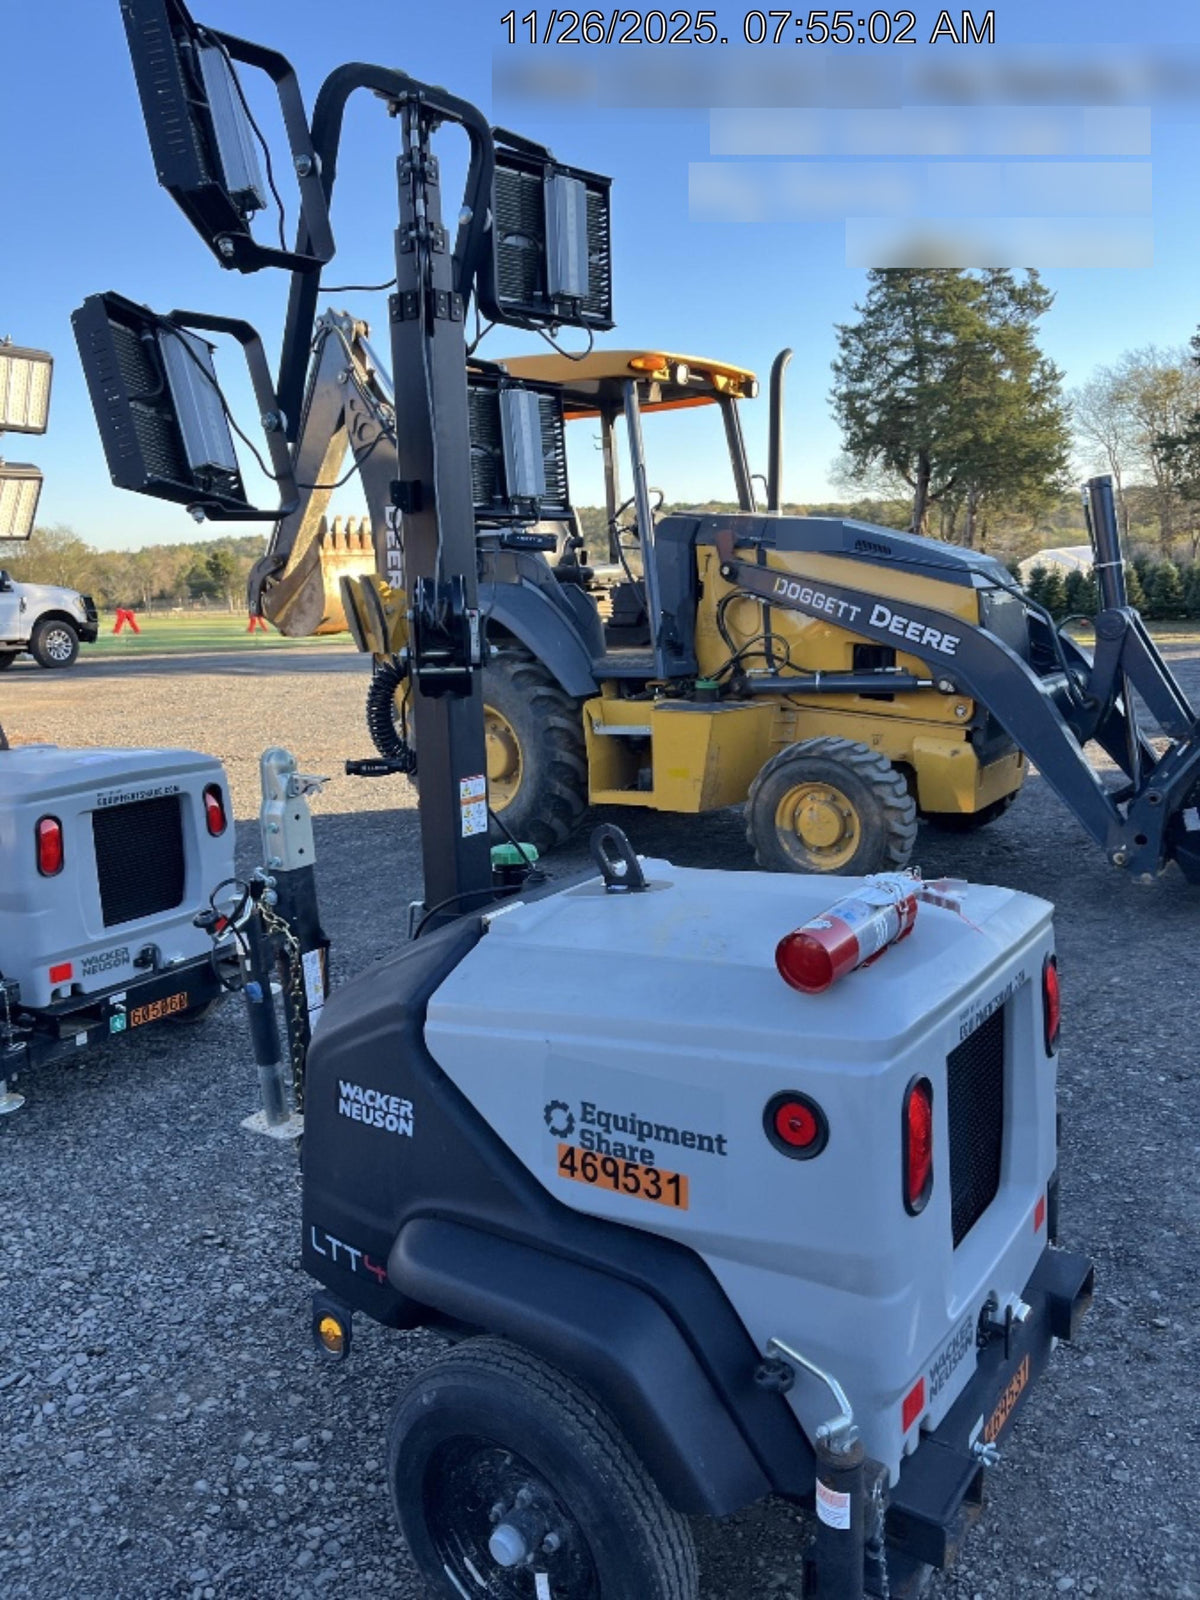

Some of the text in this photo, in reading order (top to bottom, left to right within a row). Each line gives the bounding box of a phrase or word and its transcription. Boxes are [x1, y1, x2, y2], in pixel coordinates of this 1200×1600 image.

[773, 577, 961, 656] DOGGETT DEERE
[338, 1080, 414, 1119] WACKER
[338, 1099, 414, 1138] NEUSON
[579, 1128, 655, 1166] Share
[580, 1101, 728, 1156] Equipment
[559, 1146, 681, 1206] 469531
[311, 1226, 387, 1284] LTT4
